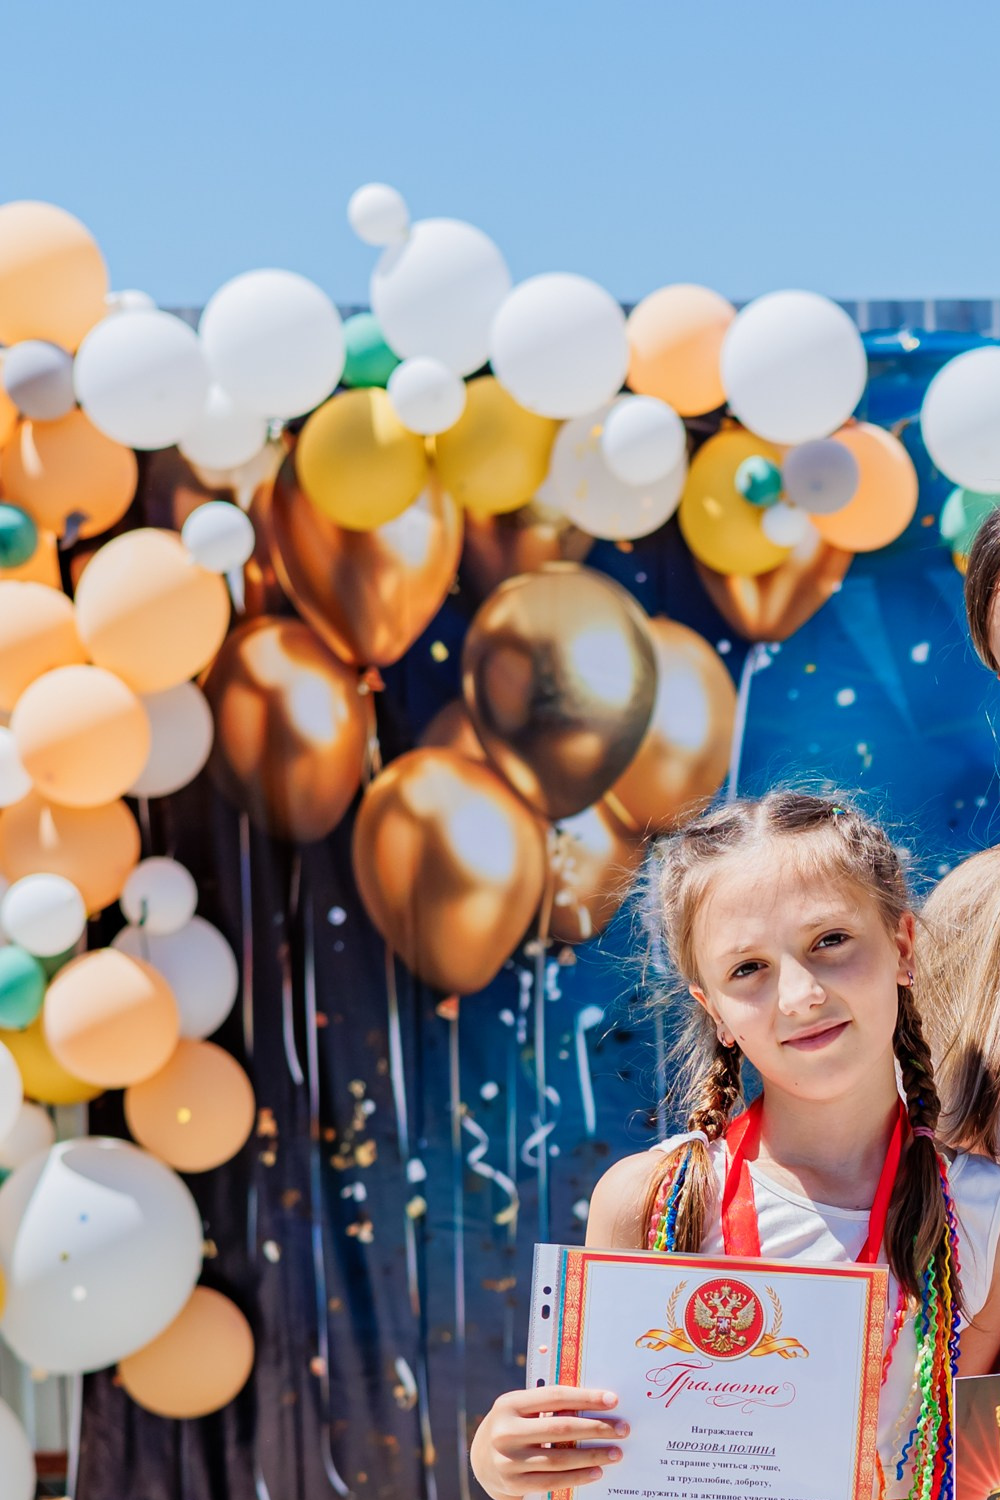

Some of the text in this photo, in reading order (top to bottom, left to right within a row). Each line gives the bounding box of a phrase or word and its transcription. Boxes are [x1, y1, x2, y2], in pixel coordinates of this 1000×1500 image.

[645, 1359, 796, 1410] Грамота
[691, 1425, 754, 1437] Награждается
[666, 1440, 776, 1455] МОРОЗОВА ПОЛИНА
[670, 1459, 710, 1468] старание
[750, 1464, 781, 1472] лучше,
[678, 1475, 733, 1486] трудолюбие,
[734, 1478, 772, 1488] доброту,
[607, 1488, 640, 1496] умение
[641, 1489, 679, 1498] дружить
